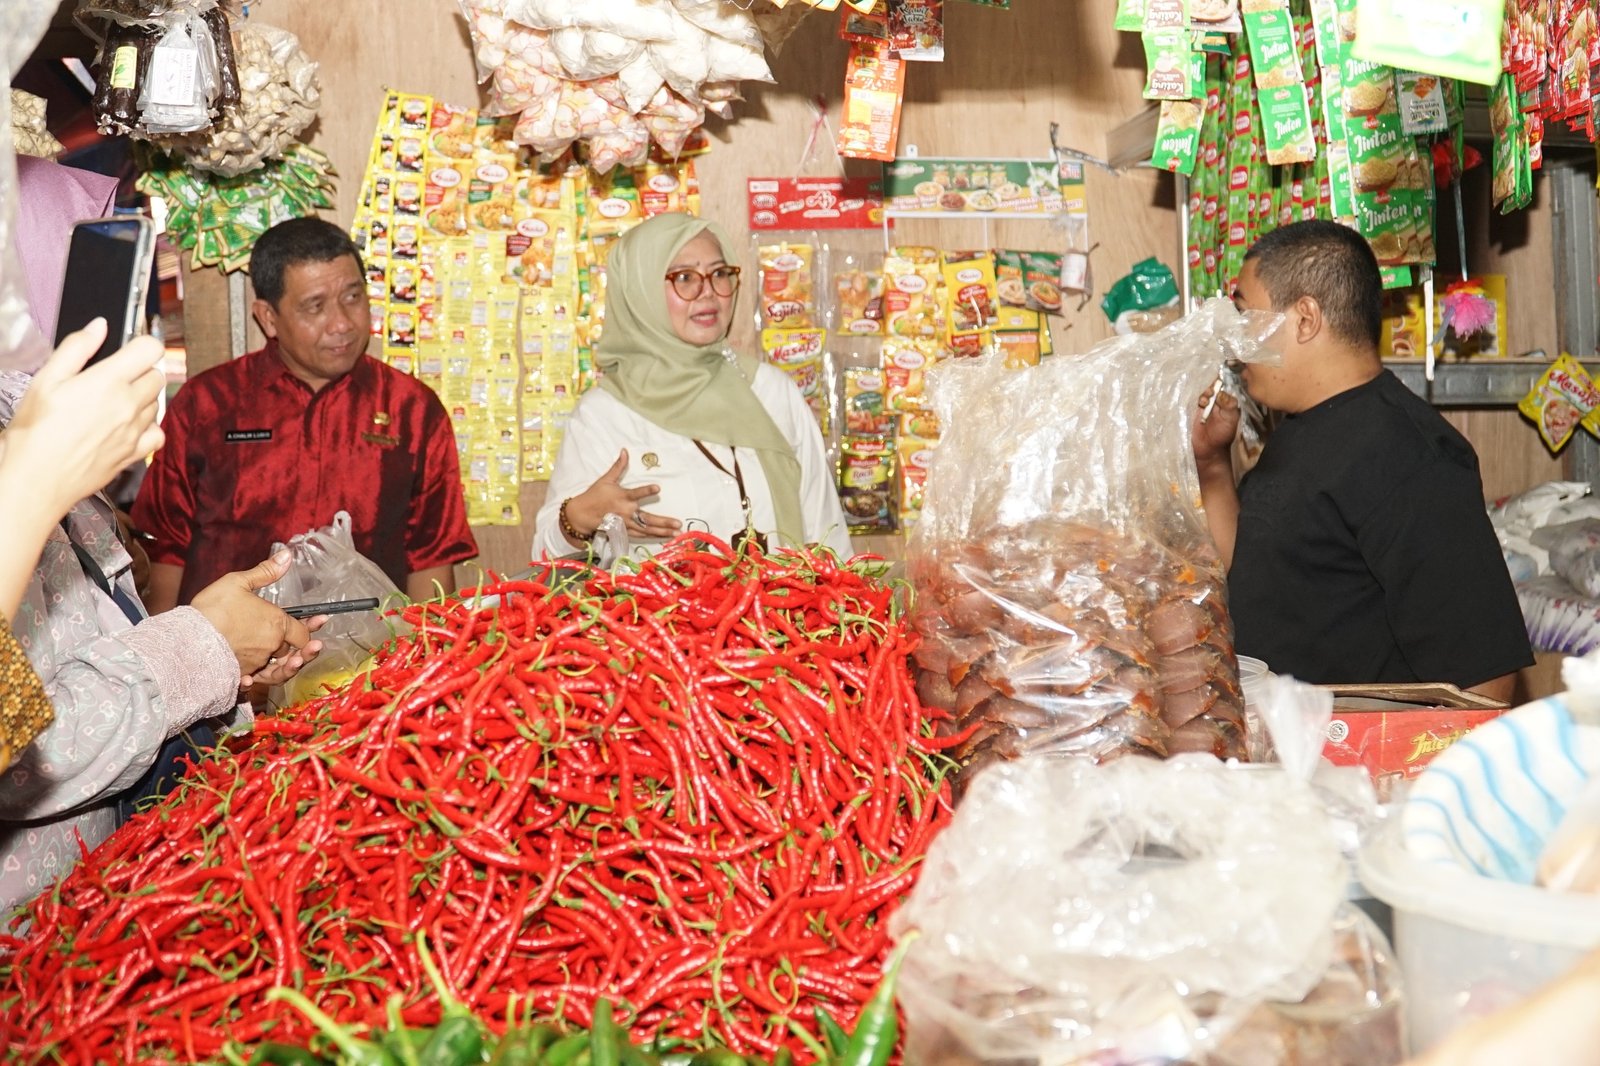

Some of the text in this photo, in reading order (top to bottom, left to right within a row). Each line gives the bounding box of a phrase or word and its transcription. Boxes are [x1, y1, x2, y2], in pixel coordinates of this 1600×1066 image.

[1261, 41, 1290, 64] Jinten
[1346, 59, 1383, 81] Jinte
[1274, 117, 1302, 140] Jinten
[1161, 134, 1194, 156] Jinten
[1354, 130, 1396, 157] Jinten
[1366, 204, 1408, 232] Jinten
[772, 334, 819, 362] Masako
